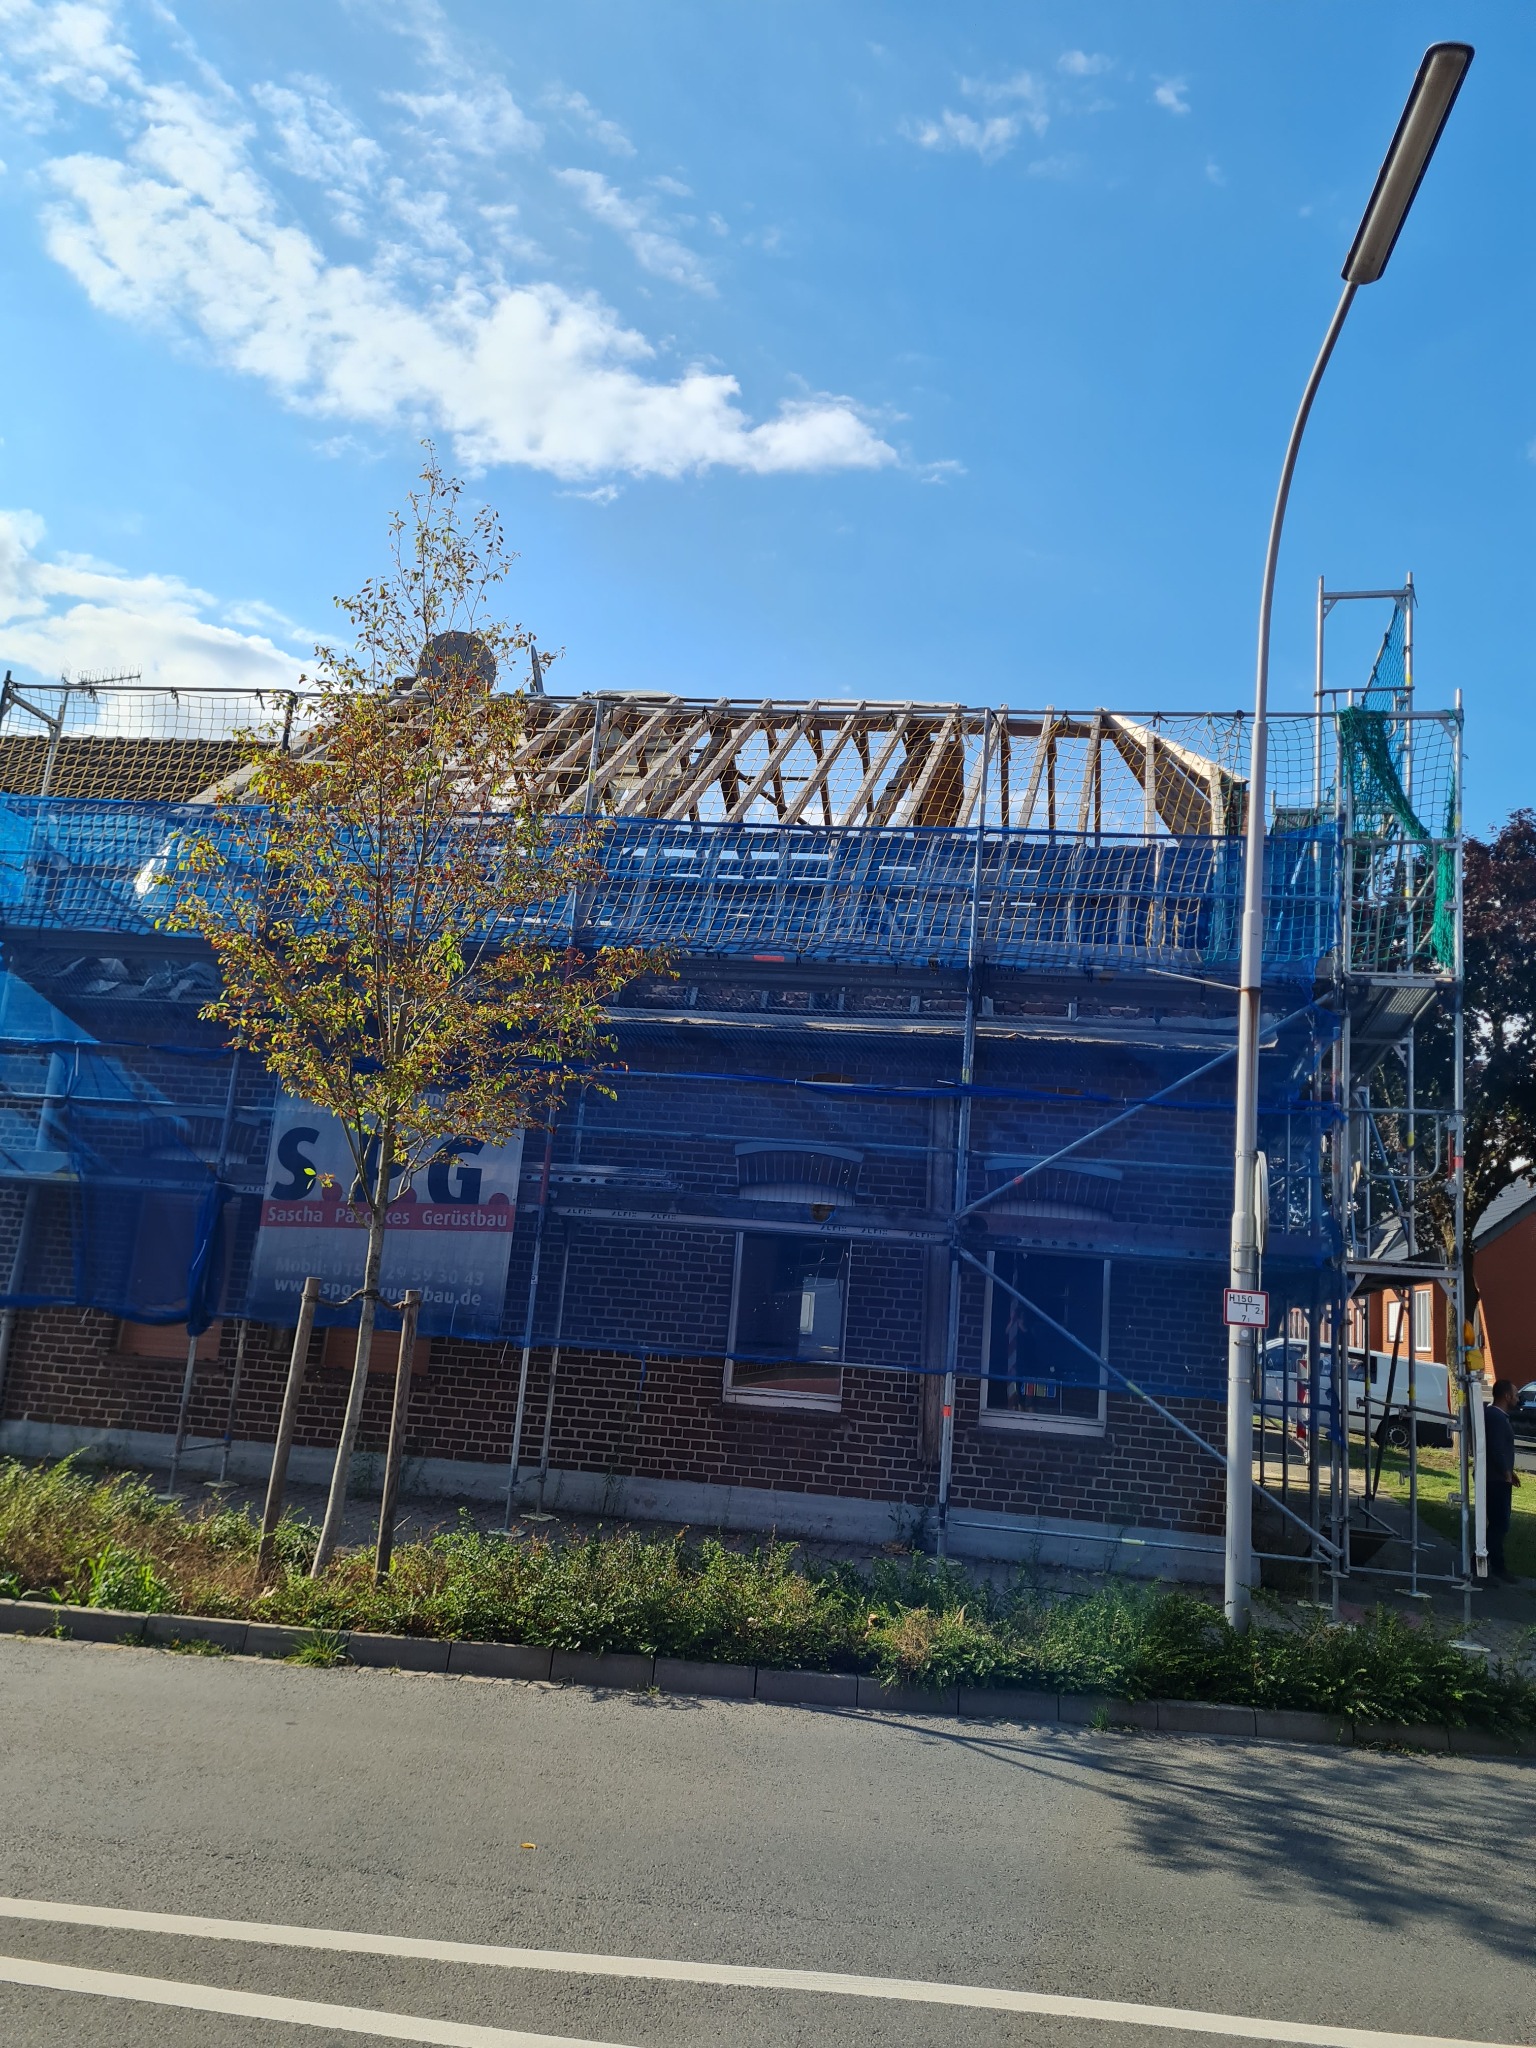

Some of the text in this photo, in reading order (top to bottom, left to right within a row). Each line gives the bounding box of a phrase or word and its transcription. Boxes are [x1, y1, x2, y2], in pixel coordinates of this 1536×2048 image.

[268, 1205, 323, 1222] Sascha
[422, 1209, 507, 1228] Gerüstbau
[275, 1257, 327, 1275] Mobil:
[1229, 1294, 1253, 1303] H150
